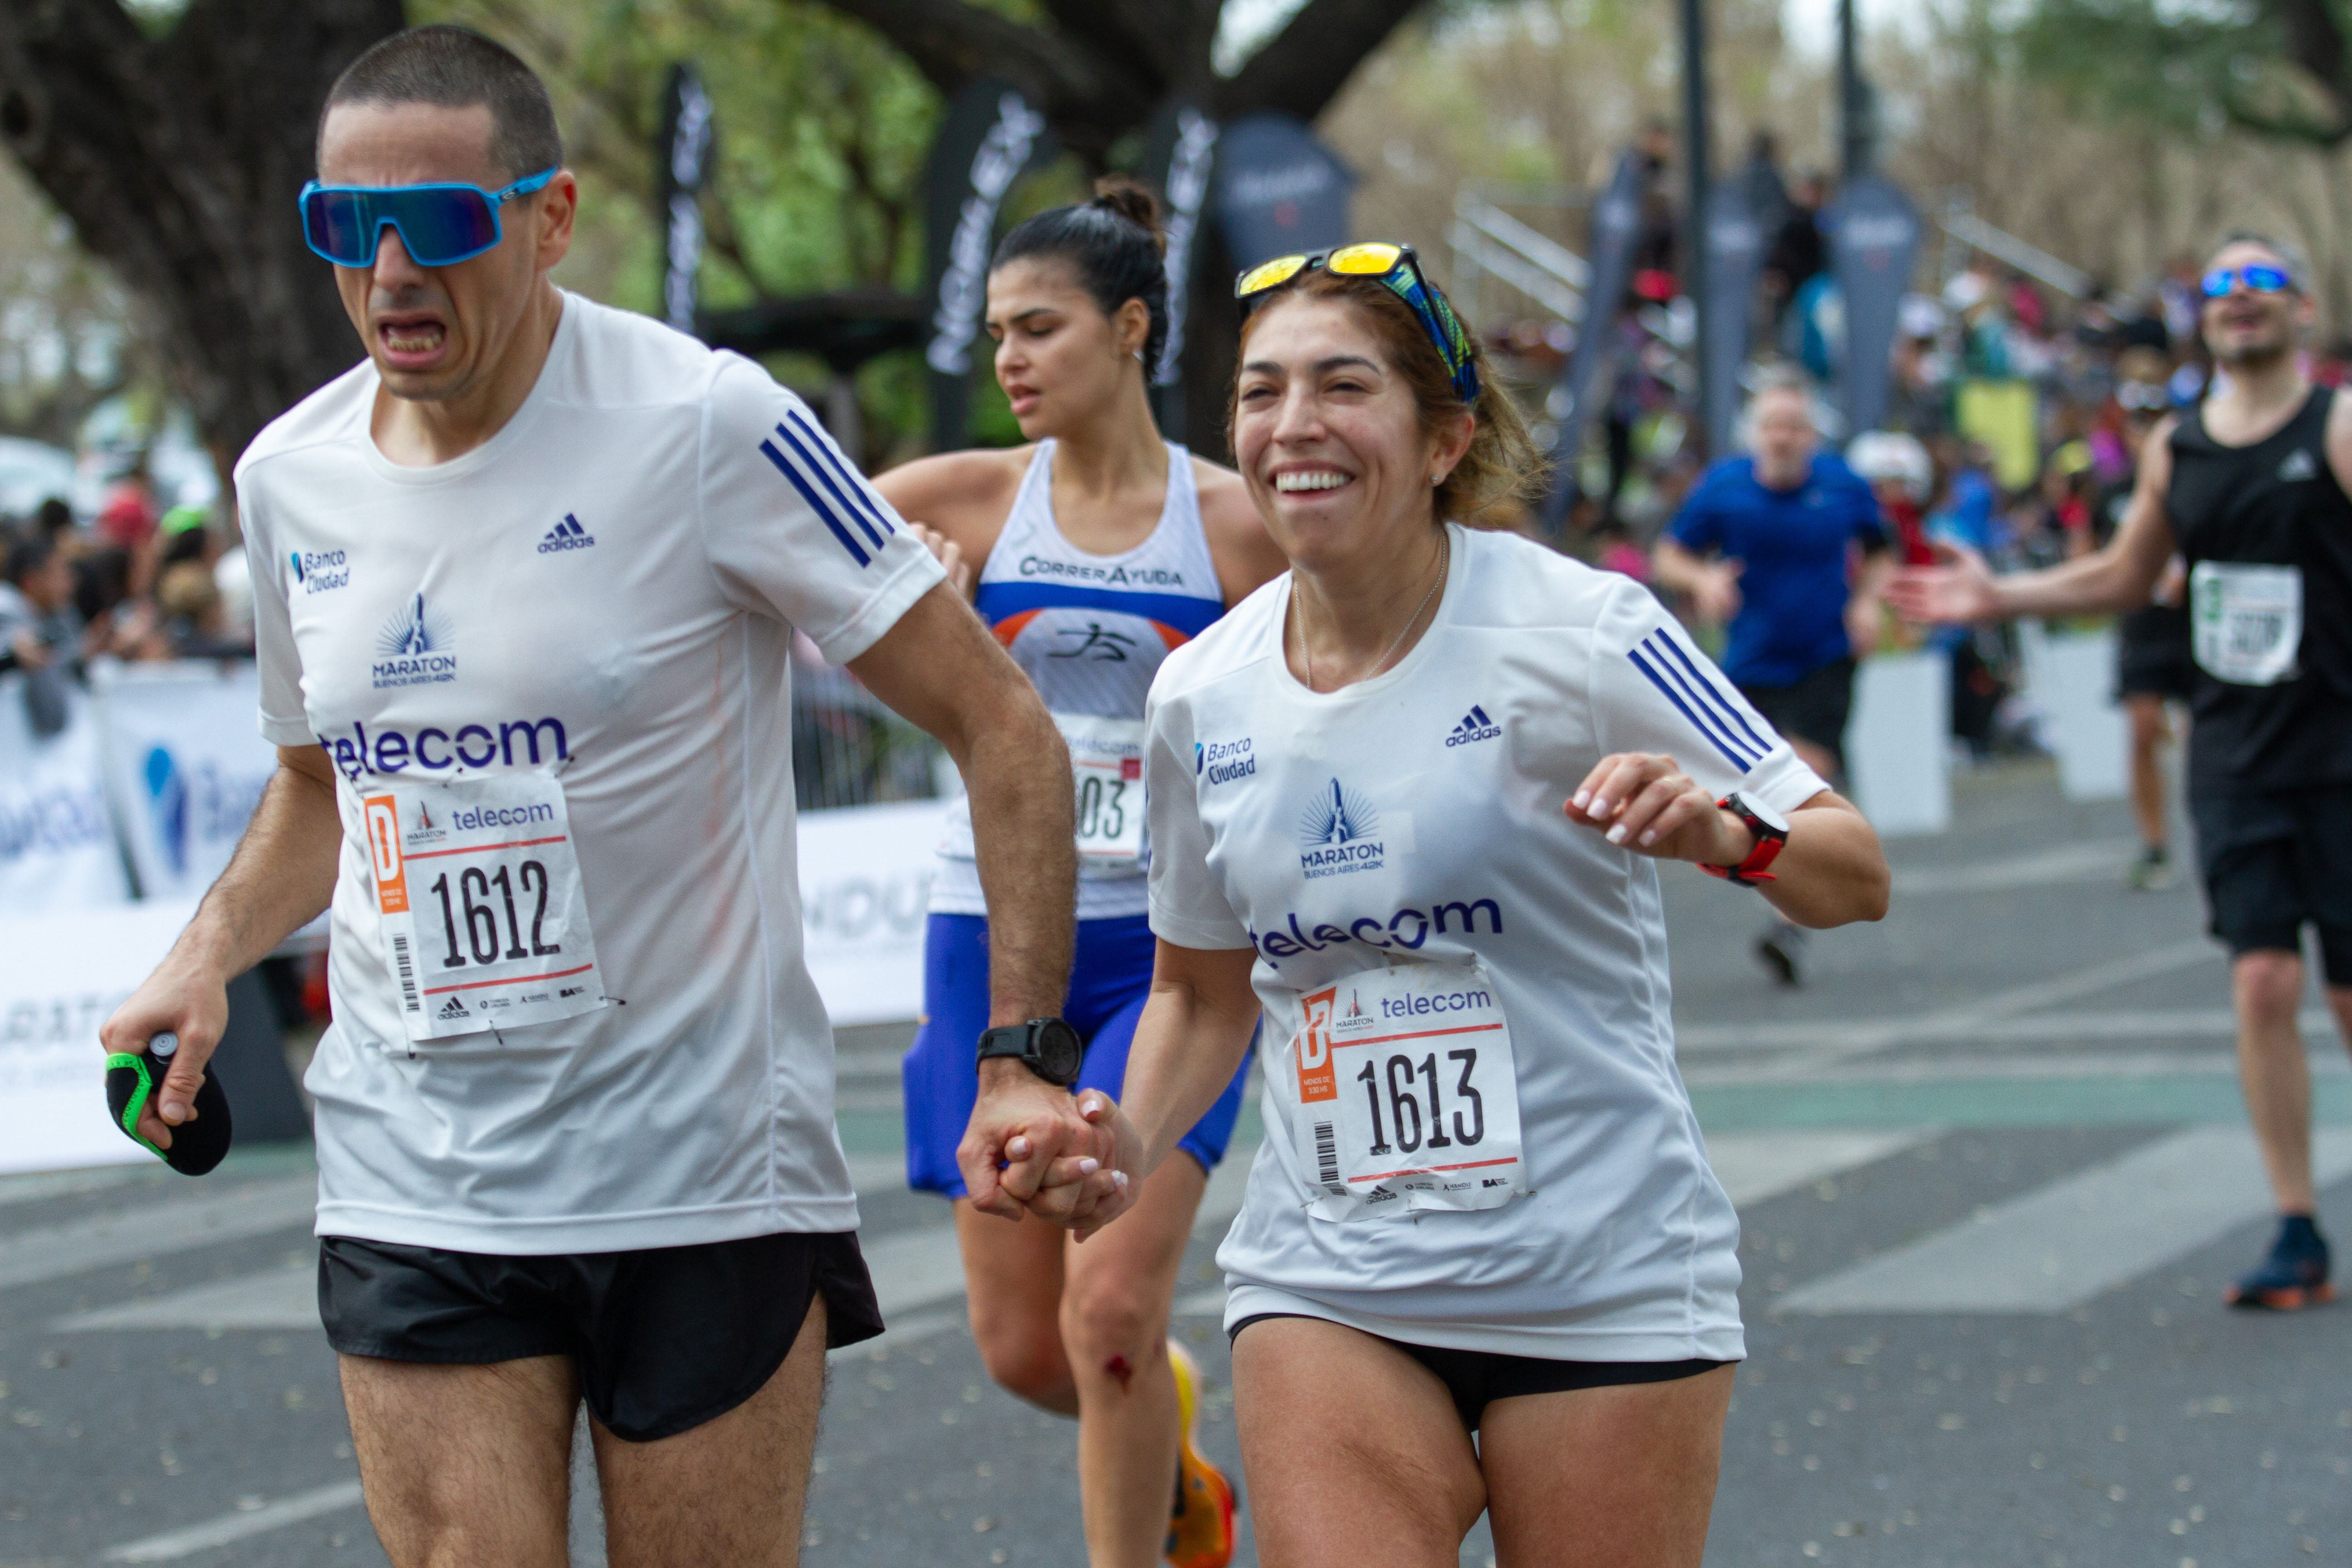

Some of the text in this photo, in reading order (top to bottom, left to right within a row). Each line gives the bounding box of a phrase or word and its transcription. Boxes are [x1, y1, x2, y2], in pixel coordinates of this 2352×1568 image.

[538, 534, 595, 554] adidas
[304, 549, 346, 572] Banco
[372, 655, 456, 678] MARATON
[317, 716, 568, 781] telecom
[1445, 725, 1502, 748] adidas
[1207, 737, 1251, 762] Banco
[1208, 753, 1256, 785] Ciudad
[452, 802, 554, 832] telecom
[1301, 842, 1384, 869] MARATON
[1303, 867, 1335, 880] BUENOS
[430, 860, 561, 968] 1612
[1250, 898, 1503, 970] telecom
[437, 1010, 470, 1020] adidas
[1380, 990, 1491, 1019] telecom
[1336, 1018, 1374, 1028] MARATON
[1357, 1048, 1485, 1157] 1613
[1366, 1192, 1397, 1205] adidas
